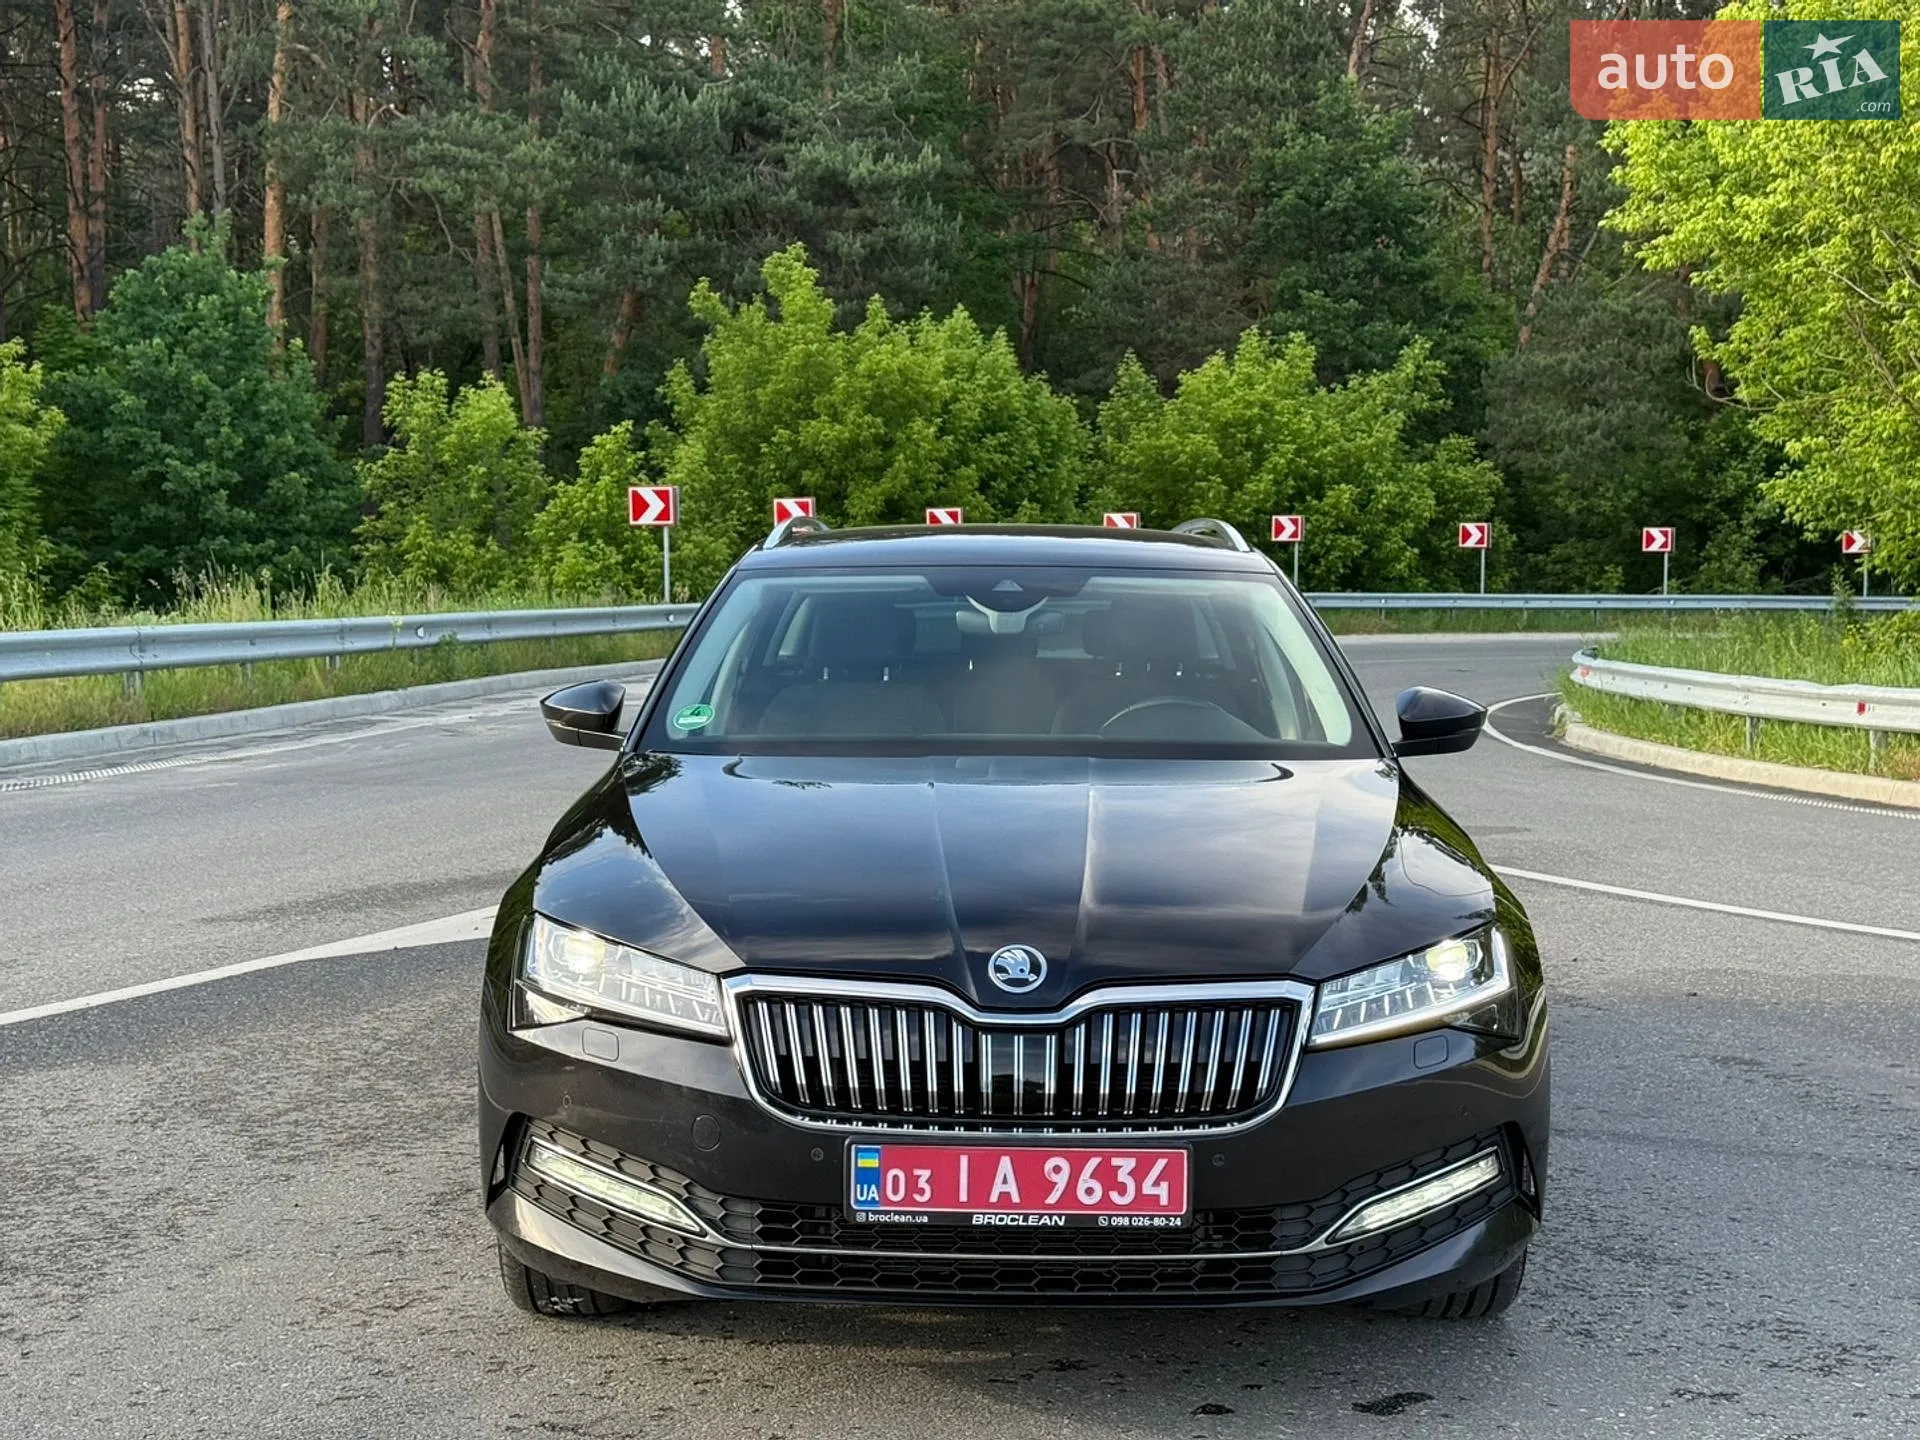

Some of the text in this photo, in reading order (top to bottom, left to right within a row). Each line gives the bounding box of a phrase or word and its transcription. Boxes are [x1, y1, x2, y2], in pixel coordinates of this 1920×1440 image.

[1043, 1156, 1170, 1207] 9634
[856, 1183, 879, 1202] UA
[868, 1212, 929, 1224] broclean.ua
[972, 1213, 1066, 1226] BROCLEAN
[1111, 1217, 1182, 1228] 098 026-80-24
